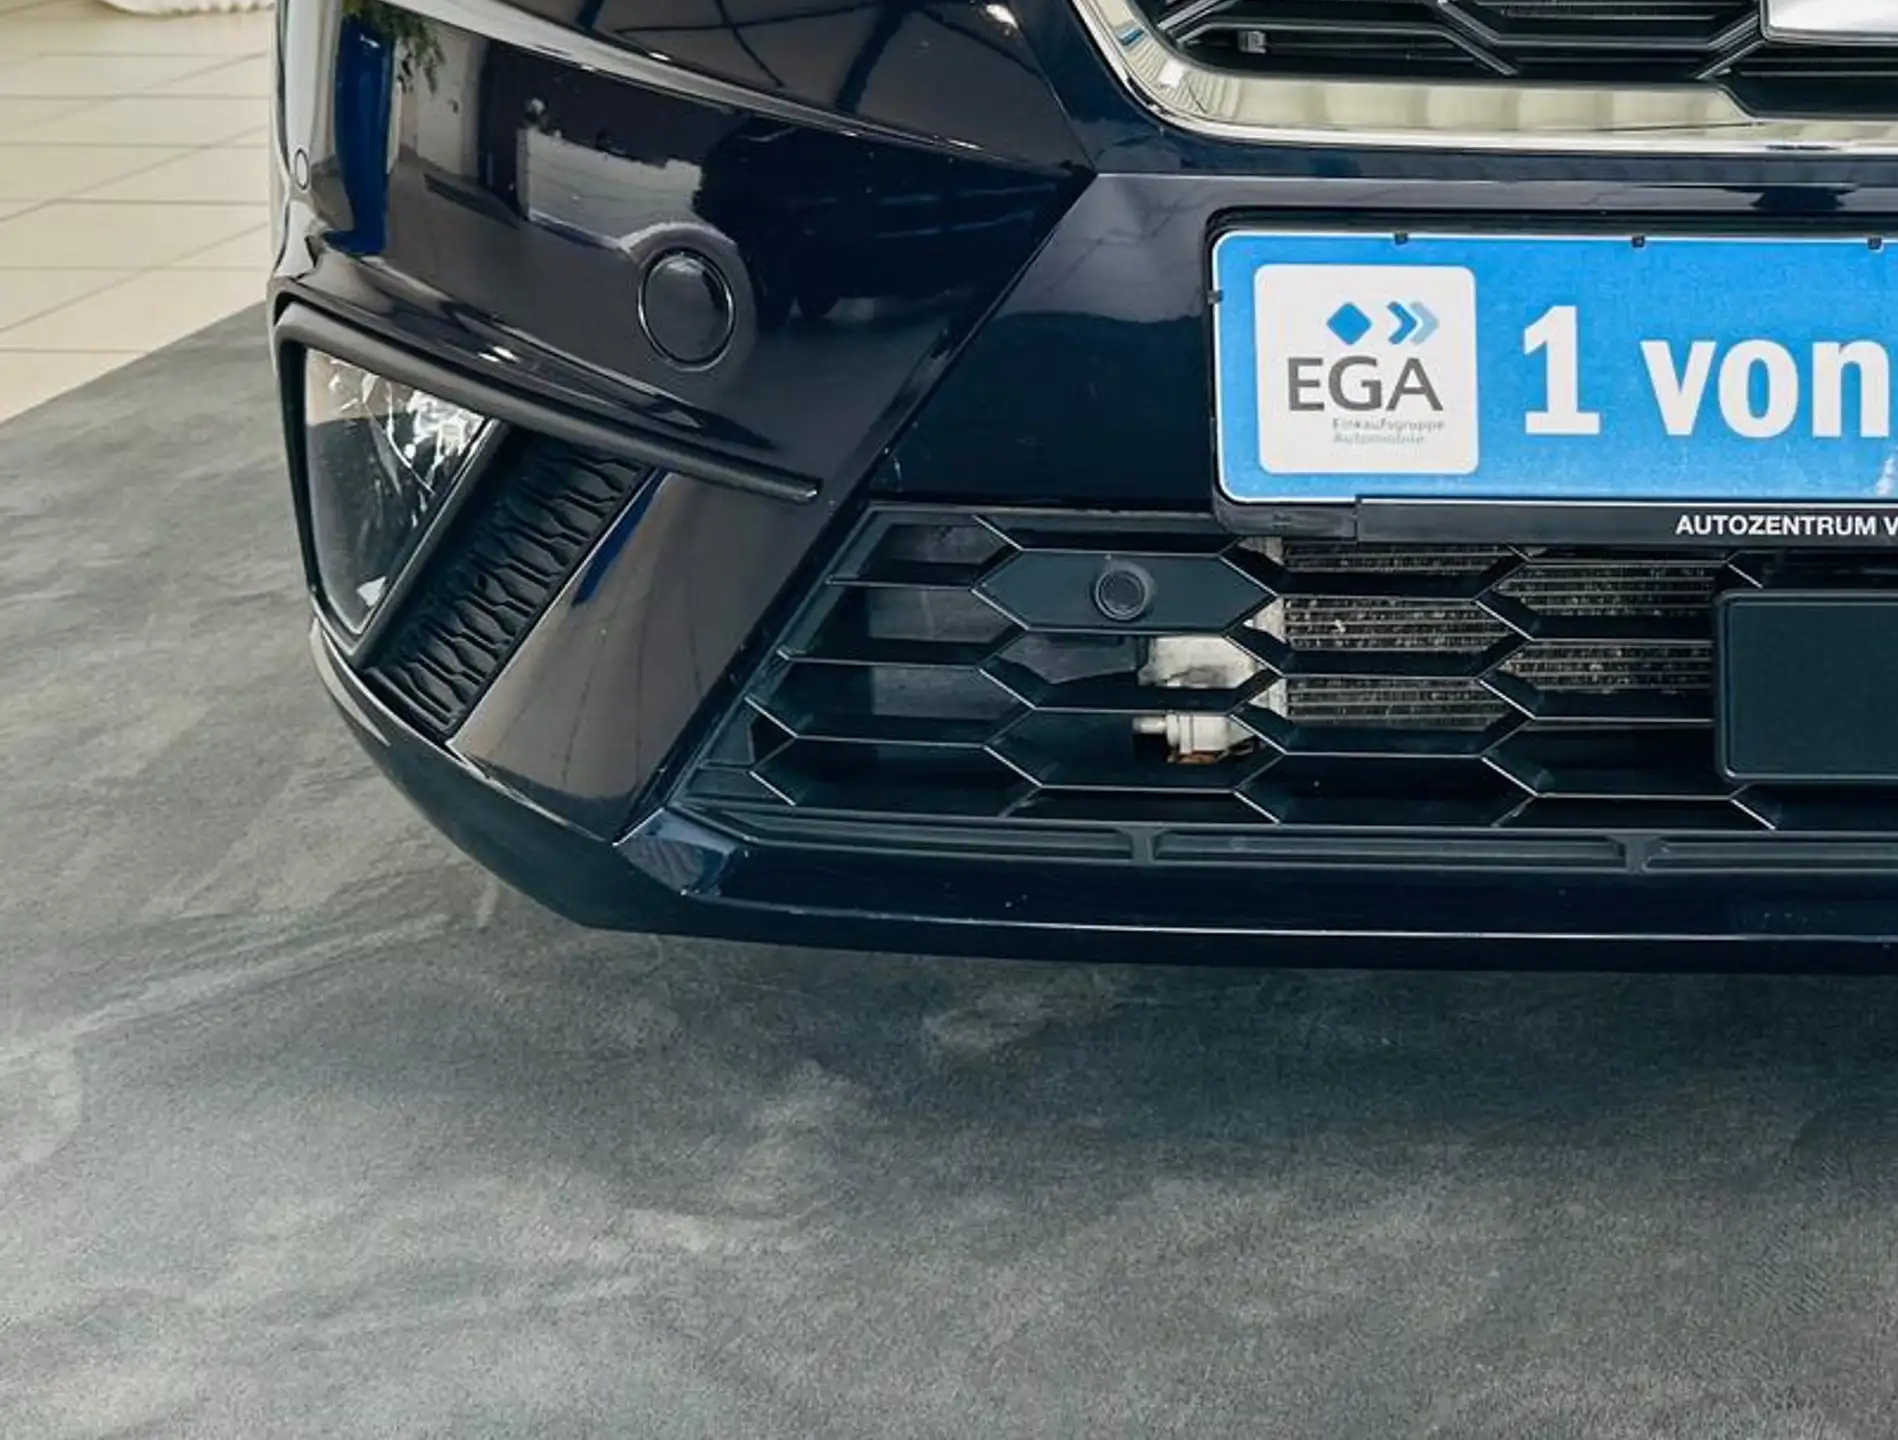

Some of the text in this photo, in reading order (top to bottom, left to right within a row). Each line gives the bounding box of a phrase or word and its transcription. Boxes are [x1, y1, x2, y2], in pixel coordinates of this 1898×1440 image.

[1287, 355, 1444, 412] EGA
[1524, 306, 1601, 435] 1
[1641, 340, 1890, 438] von
[1675, 514, 1877, 536] AUTOZENTRUM
